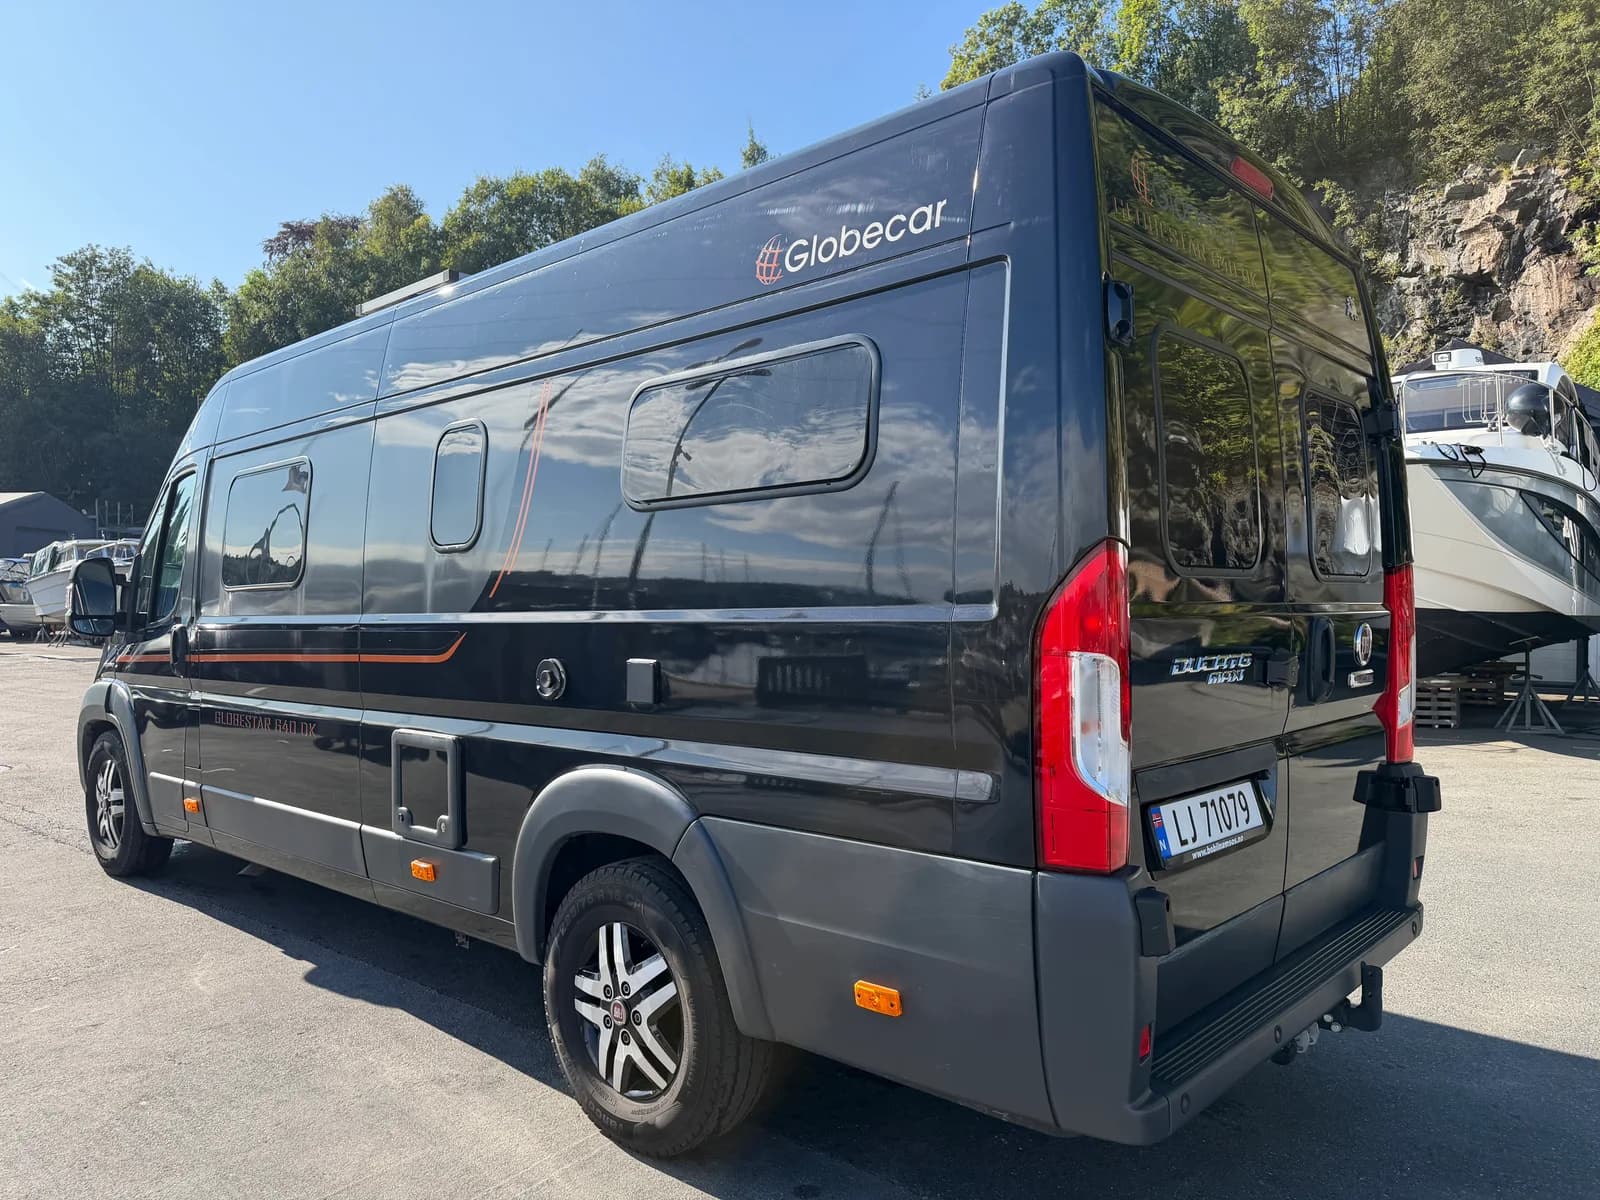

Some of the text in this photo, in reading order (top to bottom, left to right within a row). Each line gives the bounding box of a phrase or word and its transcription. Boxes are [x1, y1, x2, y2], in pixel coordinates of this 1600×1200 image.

[784, 198, 948, 273] Globecar
[1171, 653, 1253, 676] DUCATO
[214, 710, 317, 737] GLOBESTAR 640 DK
[1172, 790, 1251, 847] LJ 71079
[1159, 840, 1167, 851] N
